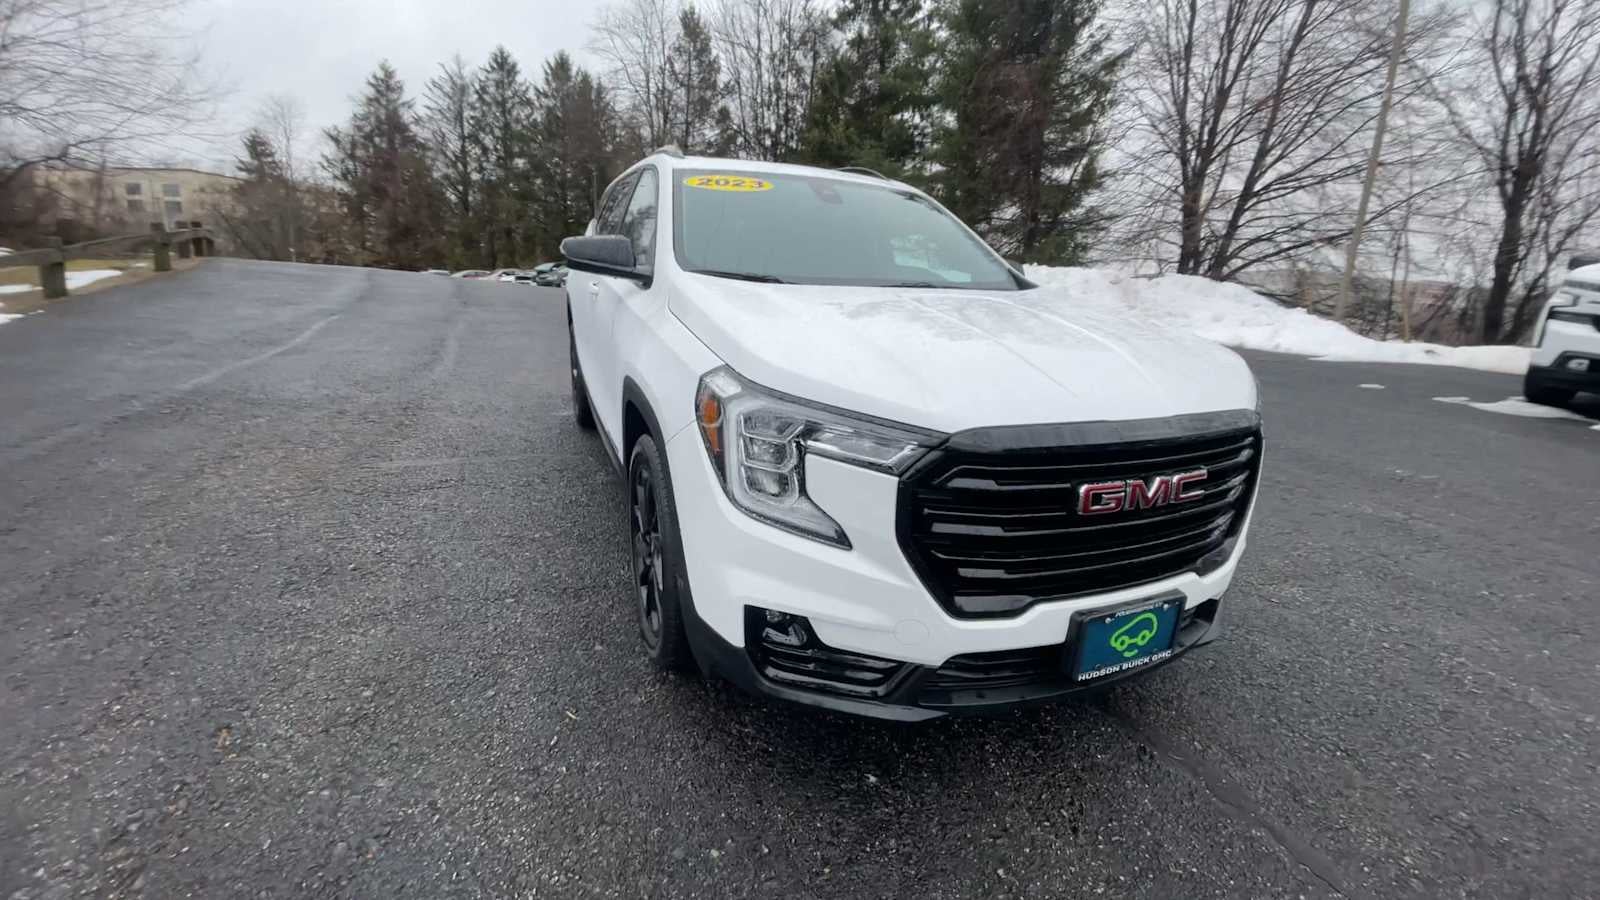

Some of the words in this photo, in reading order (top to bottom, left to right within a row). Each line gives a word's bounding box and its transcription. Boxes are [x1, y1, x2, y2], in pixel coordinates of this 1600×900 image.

[695, 177, 764, 189] 2023
[1078, 469, 1208, 515] GMC
[1078, 665, 1120, 681] HUDSON
[1122, 656, 1150, 670] BUICK
[1151, 650, 1172, 661] GMC
